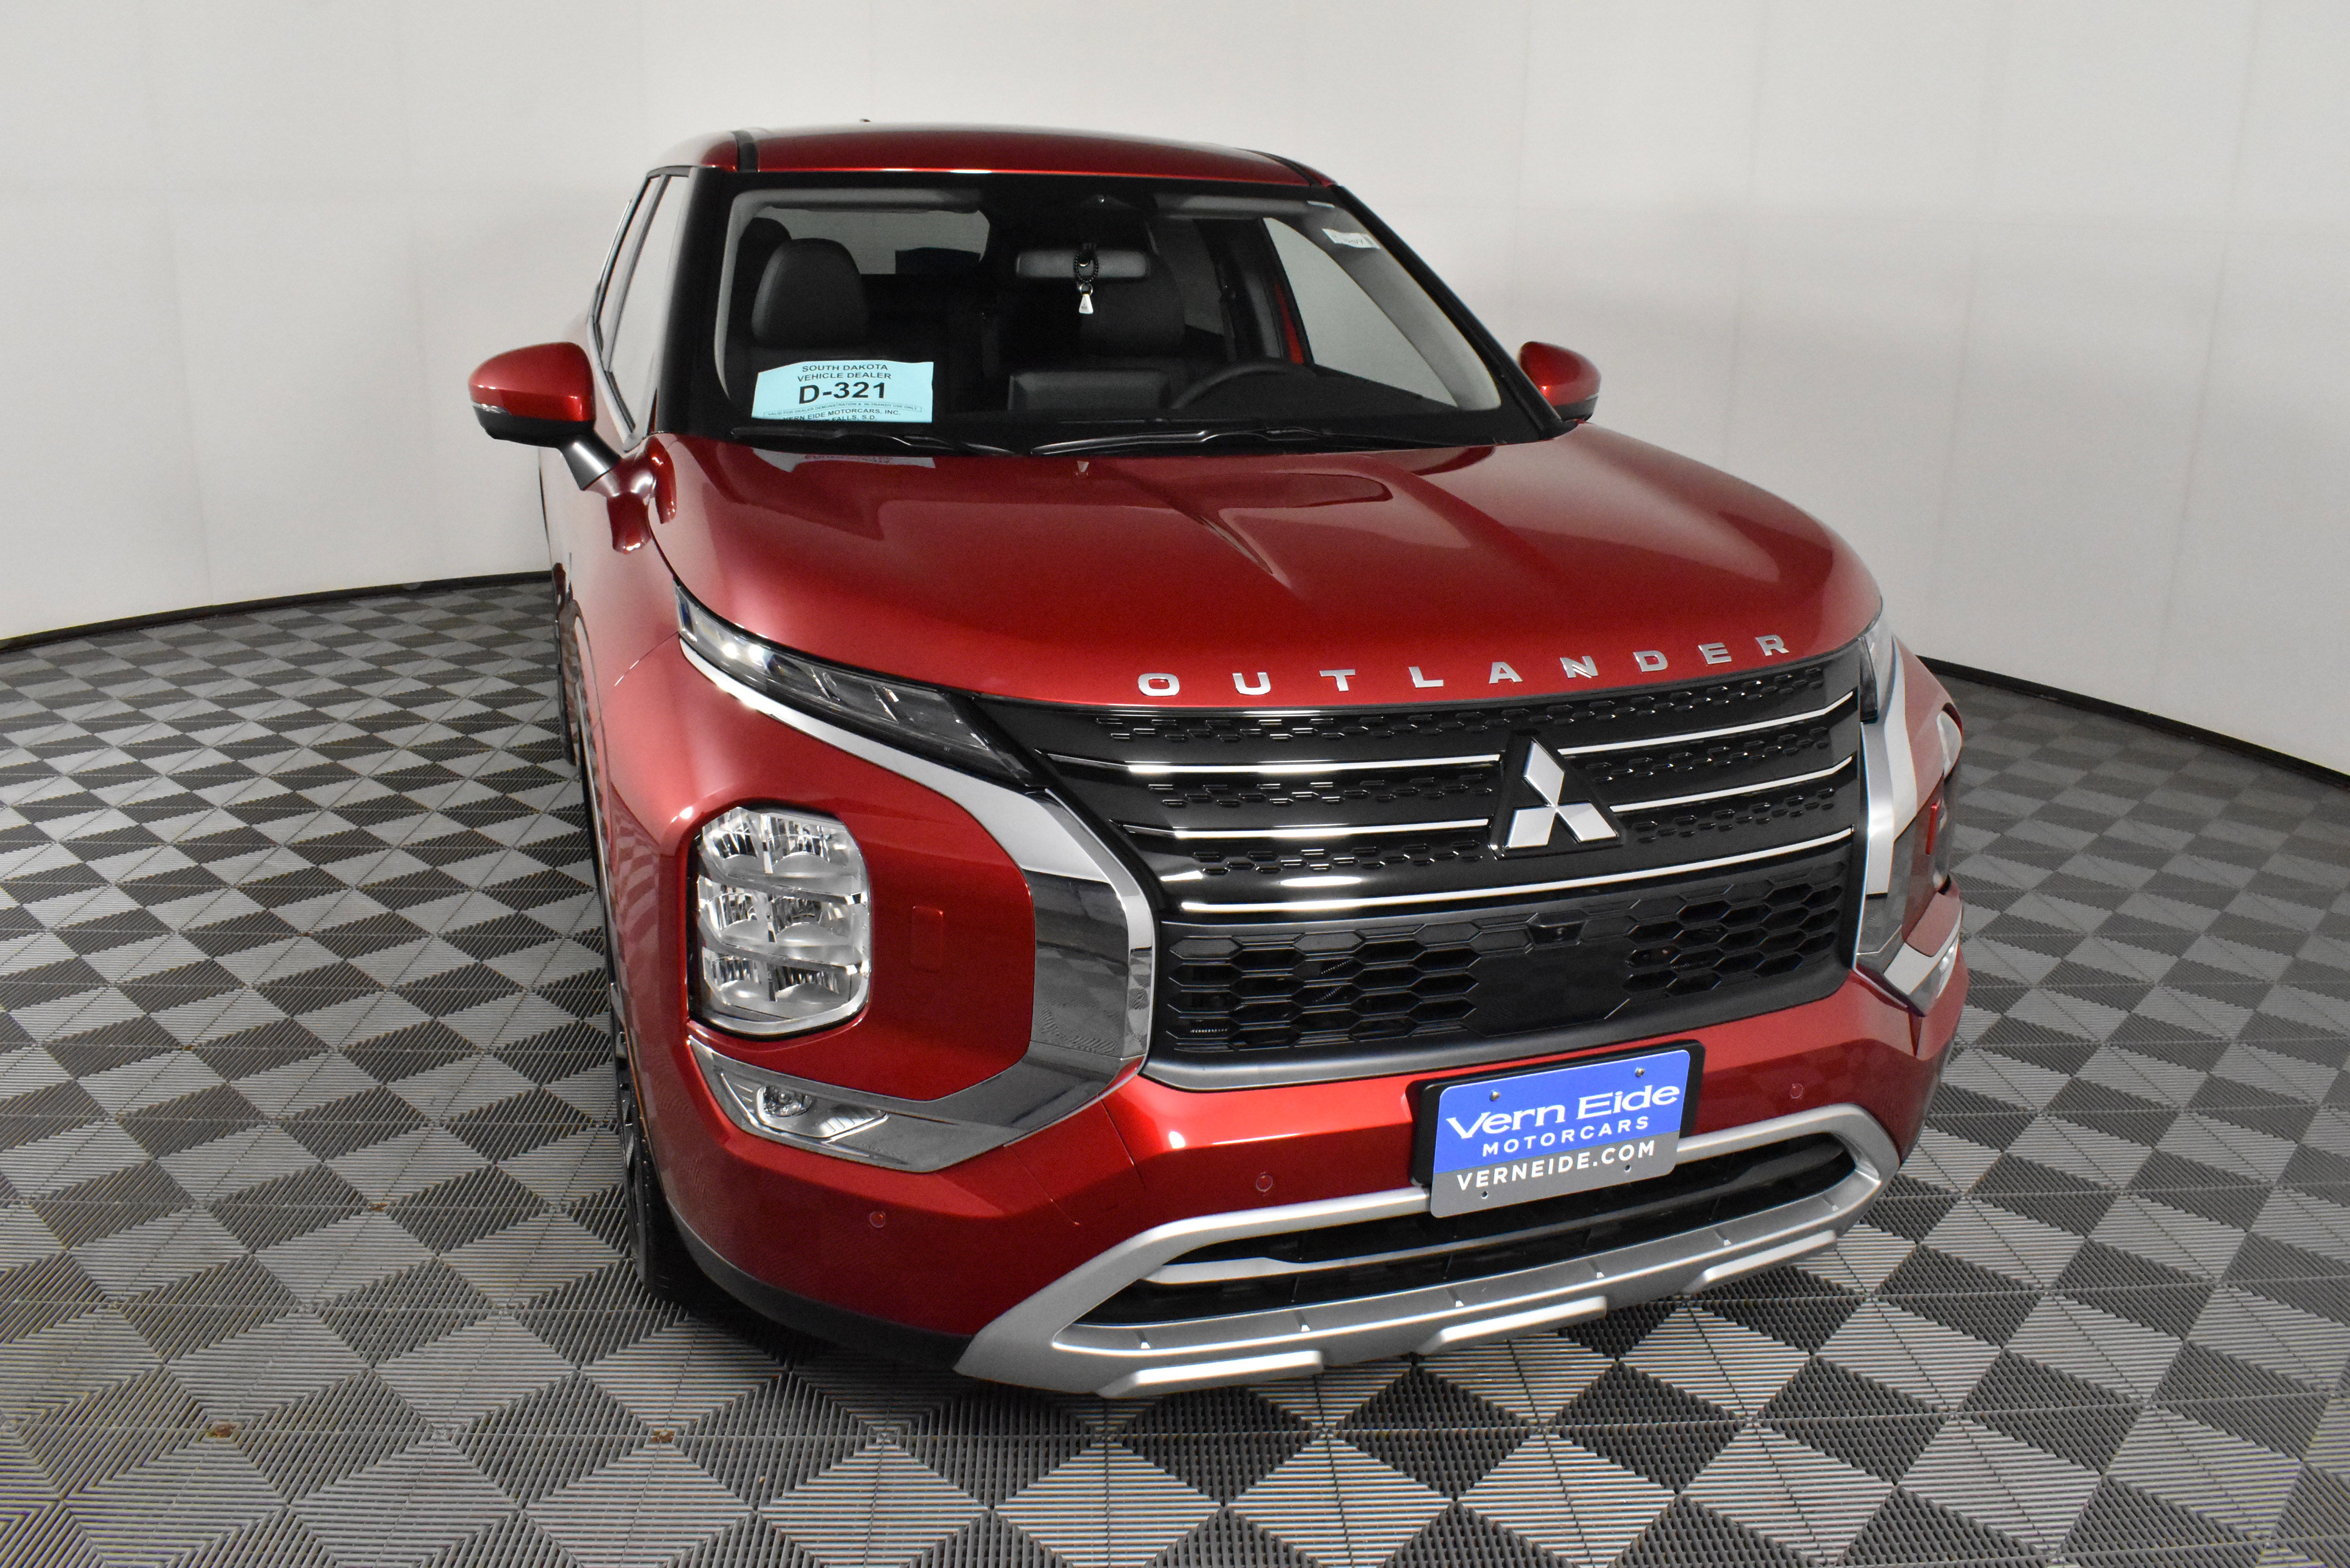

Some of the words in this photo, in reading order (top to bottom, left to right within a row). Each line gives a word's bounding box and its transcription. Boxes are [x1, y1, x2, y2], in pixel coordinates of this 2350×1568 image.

[797, 373, 843, 382] VEHICLE
[799, 381, 885, 404] D-321
[1137, 634, 1790, 697] OUTLANDER
[1446, 1104, 1565, 1139] Vern
[1576, 1085, 1680, 1120] Eide
[1482, 1116, 1649, 1157] MOTORCARS
[1457, 1140, 1655, 1191] VERNEIDE.COM
